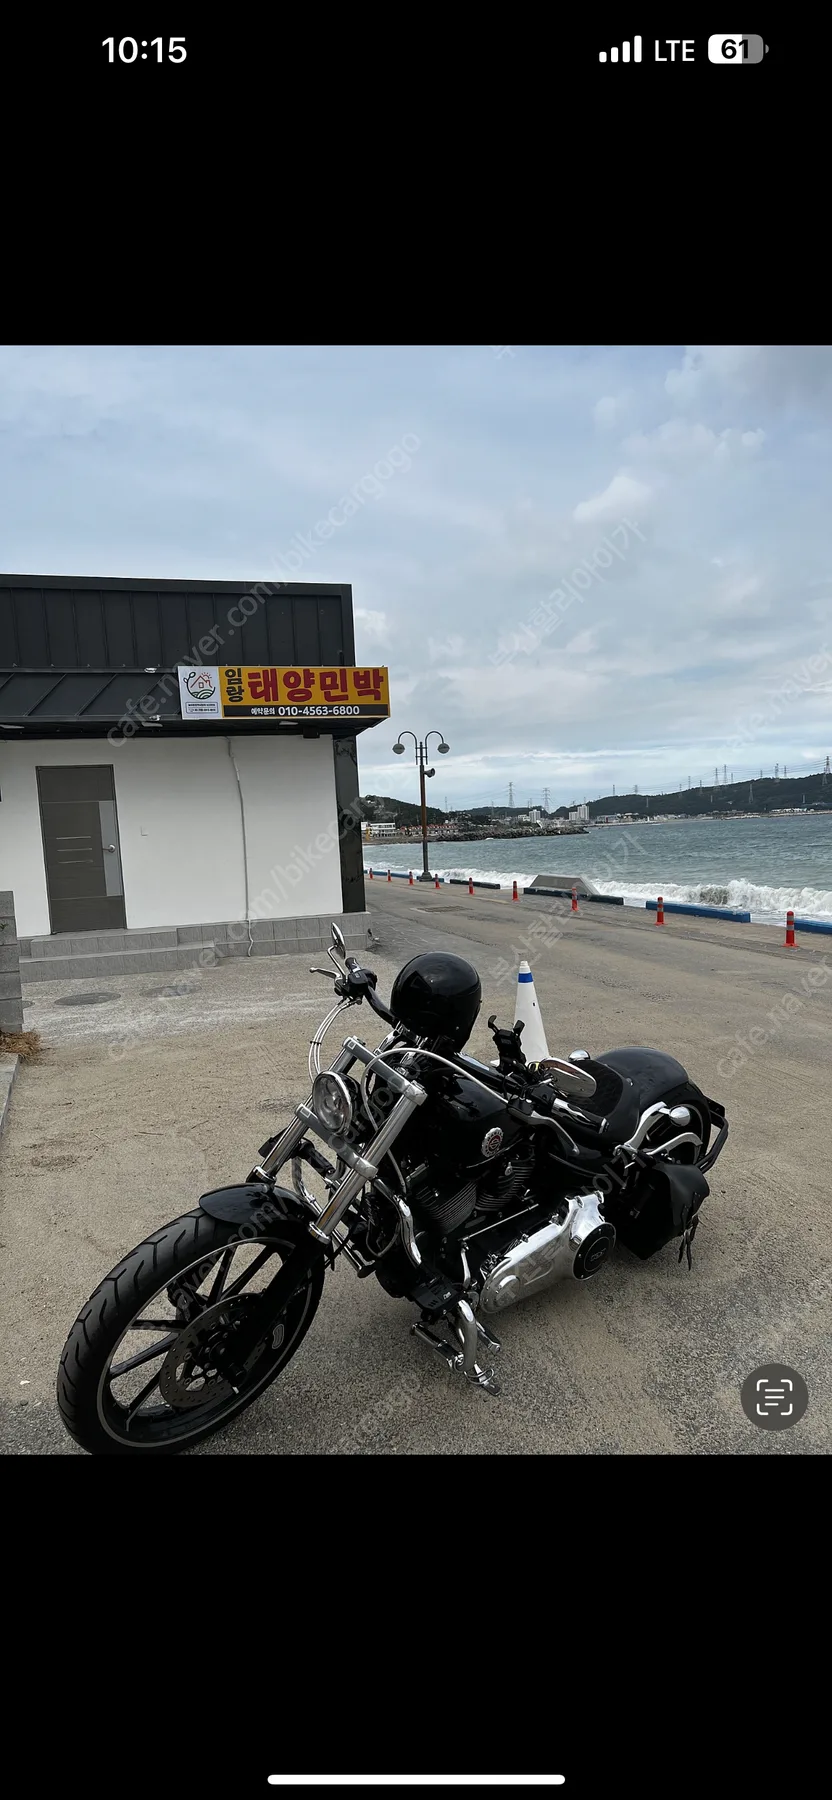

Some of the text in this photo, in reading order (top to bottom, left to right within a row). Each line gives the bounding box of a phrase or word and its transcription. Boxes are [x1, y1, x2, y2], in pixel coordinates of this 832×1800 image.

[225, 668, 245, 702] 임랑
[248, 668, 384, 702] 태양민박
[250, 706, 360, 716] 예약문의 010-4563-6800
